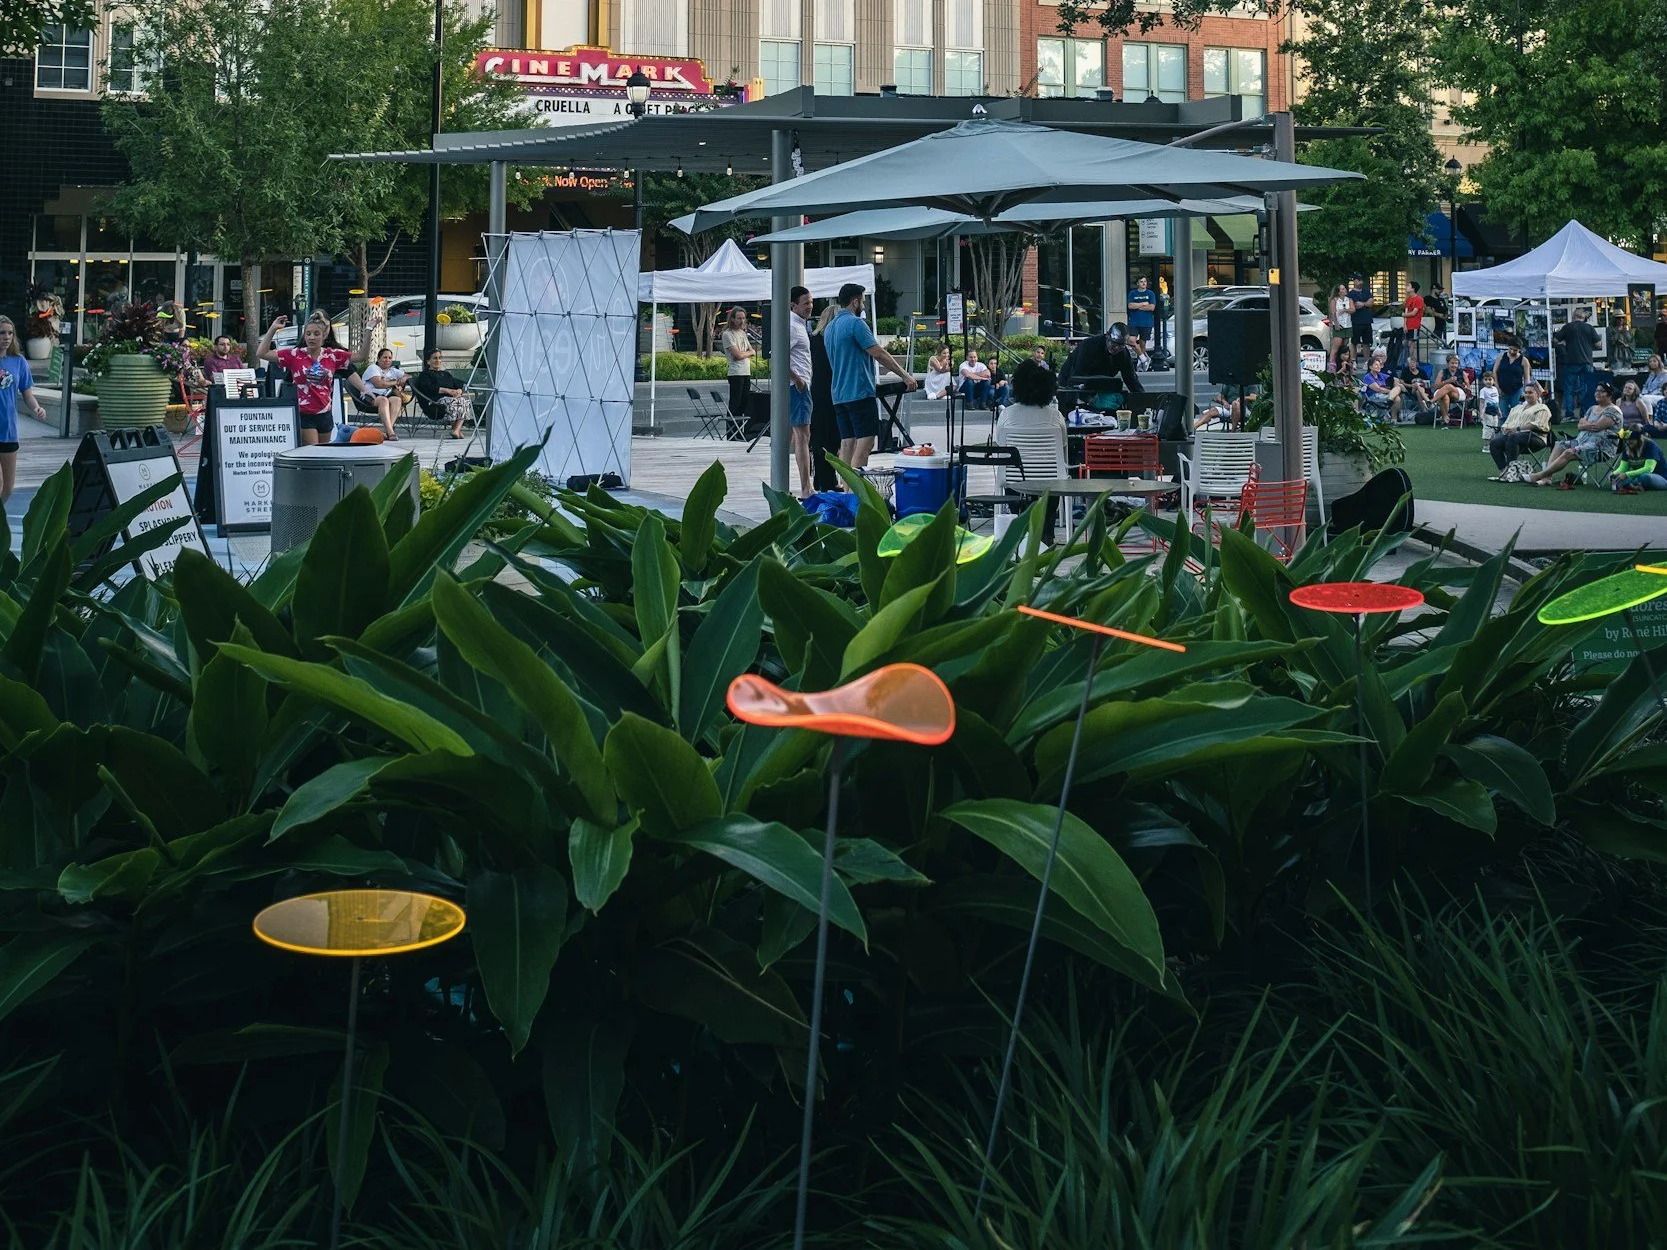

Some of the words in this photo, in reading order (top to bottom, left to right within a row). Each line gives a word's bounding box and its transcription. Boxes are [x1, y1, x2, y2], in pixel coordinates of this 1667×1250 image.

[535, 100, 591, 114] CRUELLA
[613, 102, 621, 115] A
[554, 175, 578, 187] Now
[580, 175, 608, 190] Open
[240, 412, 273, 421] FOUNTAIN
[223, 425, 237, 433] OUT
[238, 424, 247, 433] OF
[249, 423, 276, 433] SERVICE
[278, 423, 291, 431] FOR
[229, 435, 287, 445] MAINTANINANCE
[238, 451, 249, 459] We
[224, 461, 235, 469] for
[1604, 627, 1619, 642] by
[1582, 650, 1613, 660] Please
[1613, 649, 1625, 659] do
